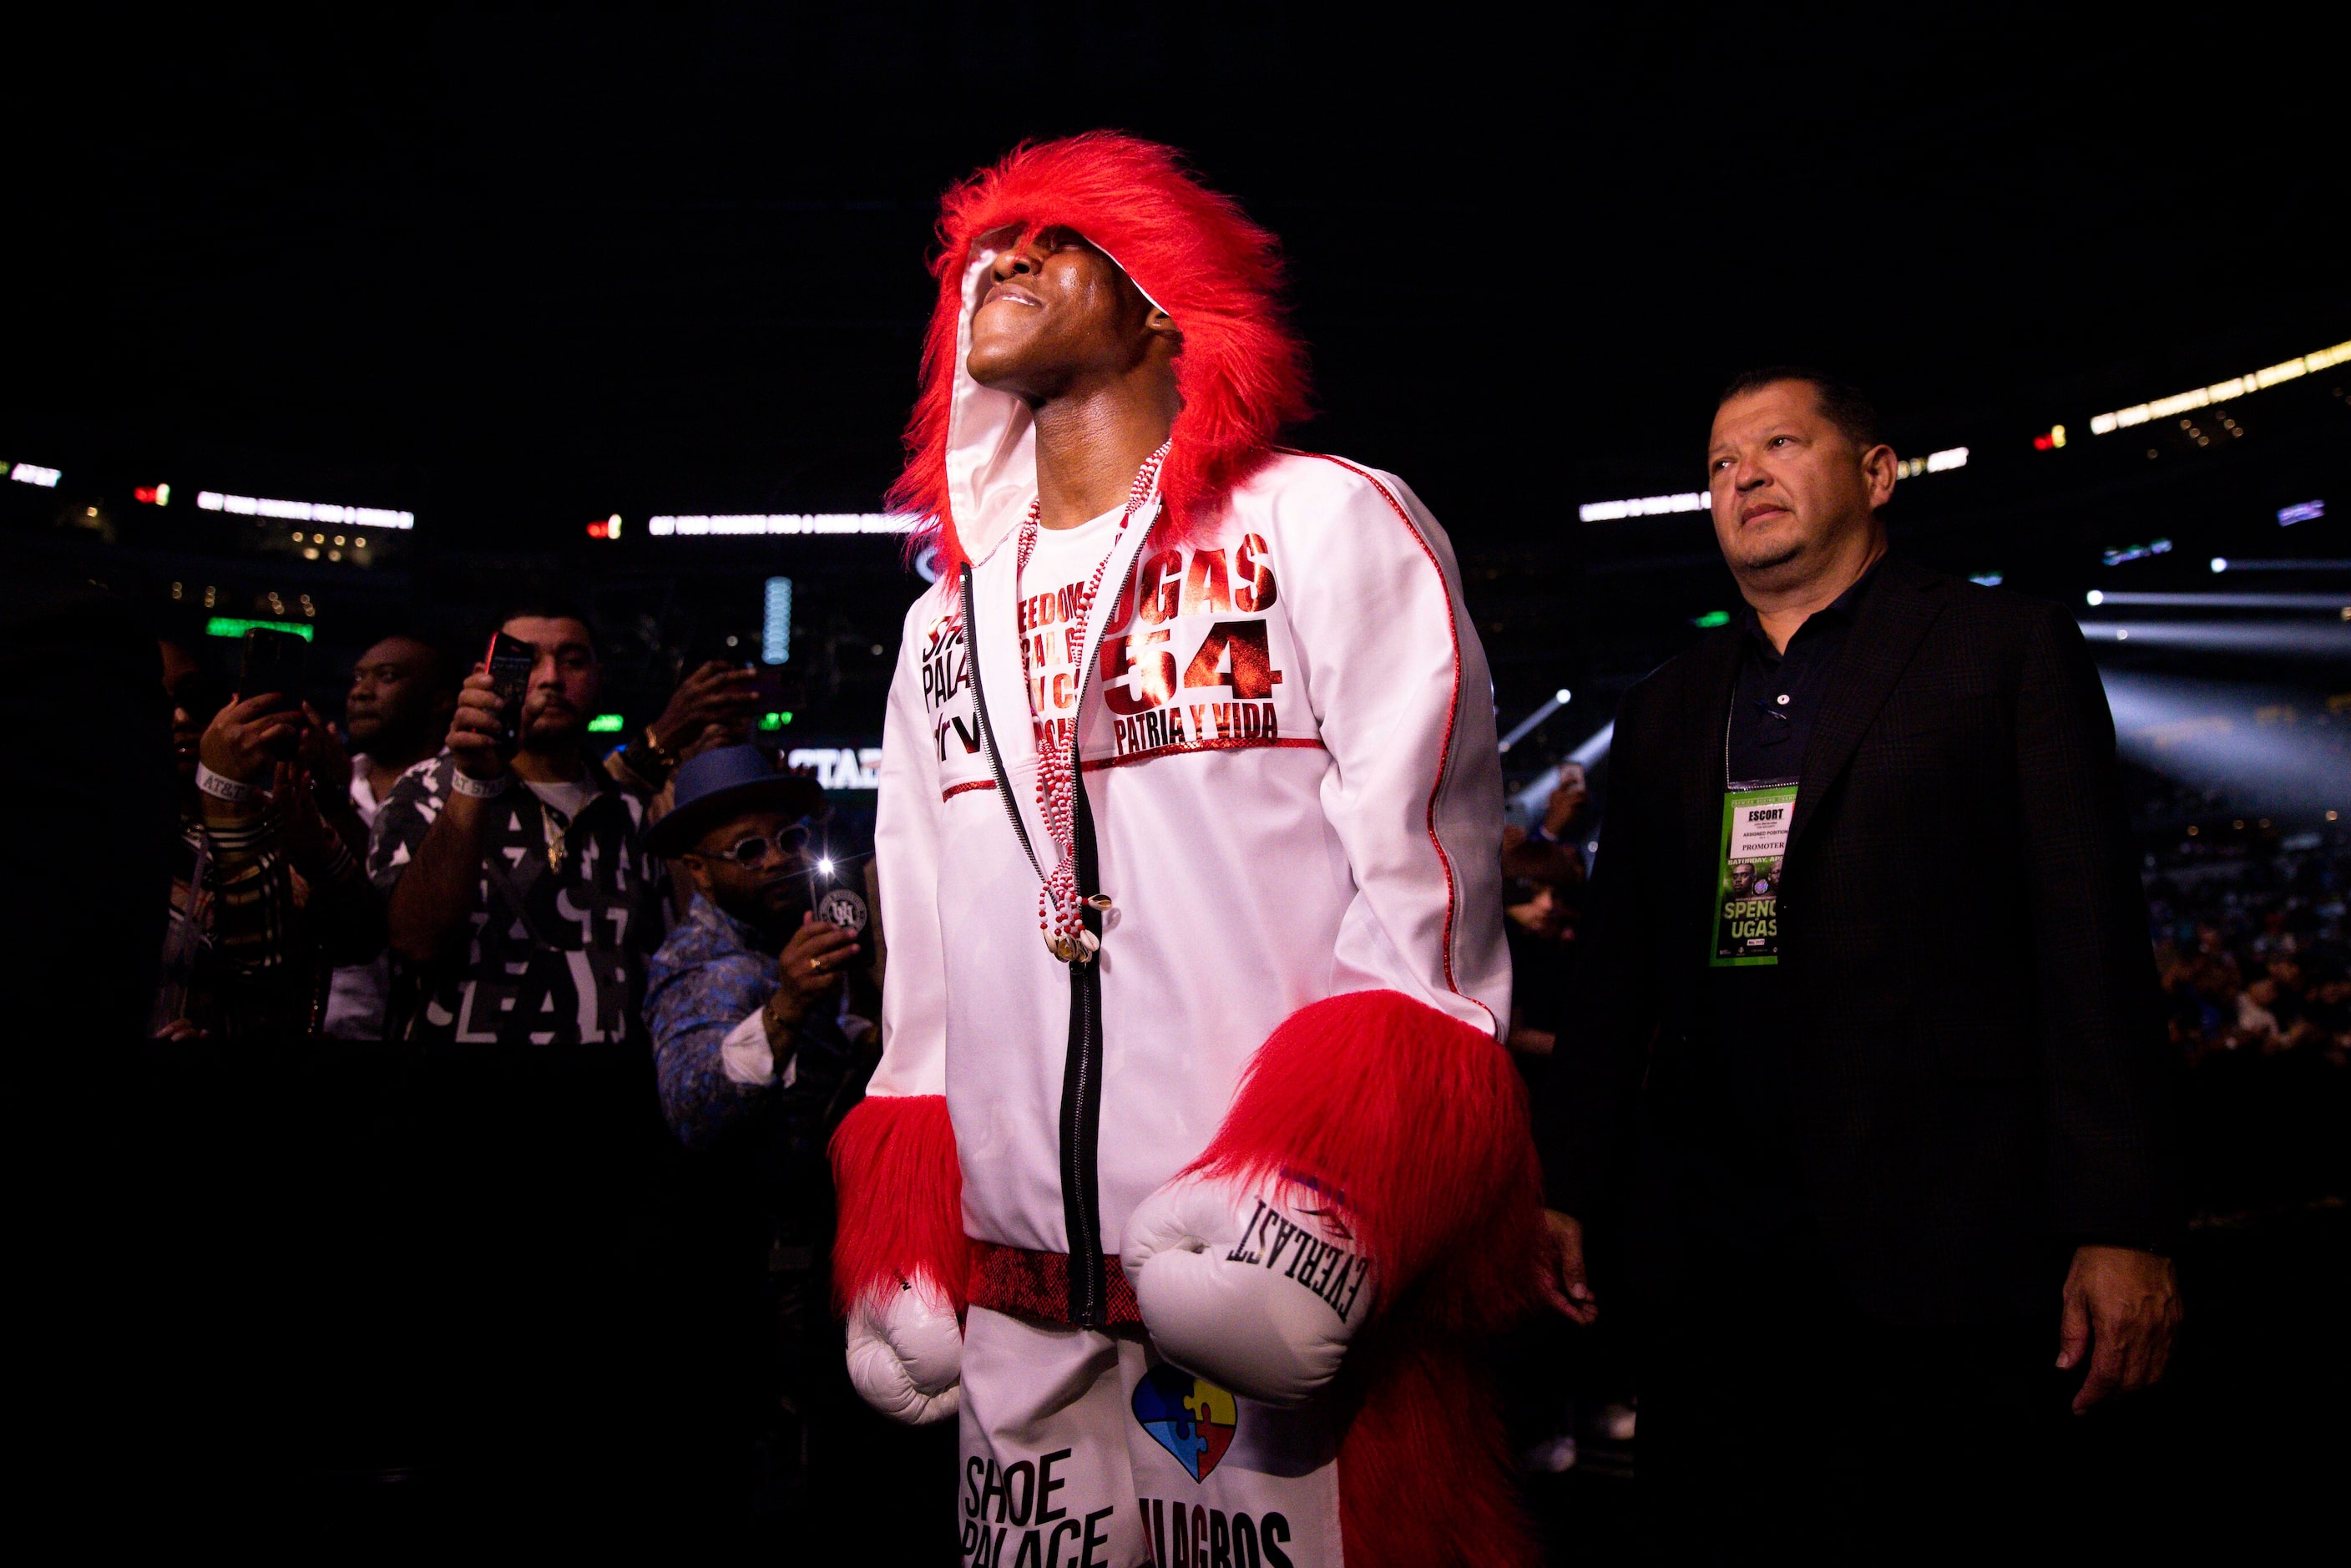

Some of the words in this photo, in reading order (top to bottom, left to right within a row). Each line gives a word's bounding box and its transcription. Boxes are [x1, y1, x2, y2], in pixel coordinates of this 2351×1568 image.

[1100, 619, 1283, 716] 54
[1113, 707, 1186, 755] PATRIA
[1189, 704, 1206, 741] Y
[1212, 702, 1278, 741] VIDA
[1748, 808, 1784, 822] ESCORT
[1742, 842, 1784, 851] PROMOTER
[1731, 918, 1777, 938] UGAS
[1226, 1196, 1370, 1324] EVERLAST
[965, 1447, 1072, 1526] SHOE
